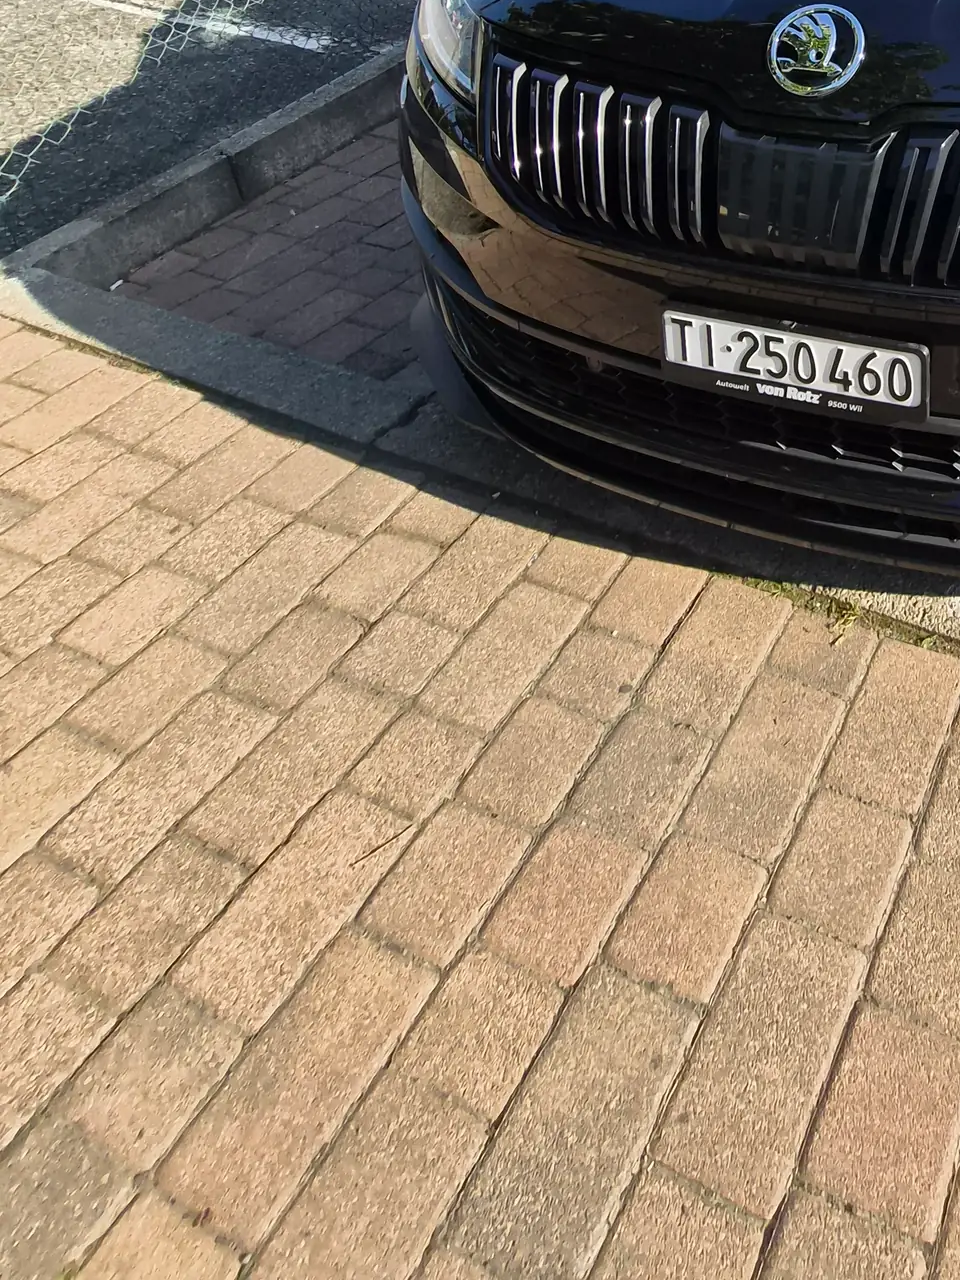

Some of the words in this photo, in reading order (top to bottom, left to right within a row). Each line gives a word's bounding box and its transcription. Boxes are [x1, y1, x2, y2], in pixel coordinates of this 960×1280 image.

[715, 379, 750, 392] Autowelt
[756, 383, 784, 398] von
[786, 385, 822, 405] Rotz
[827, 399, 847, 410] 9500
[849, 404, 863, 413] Wil
